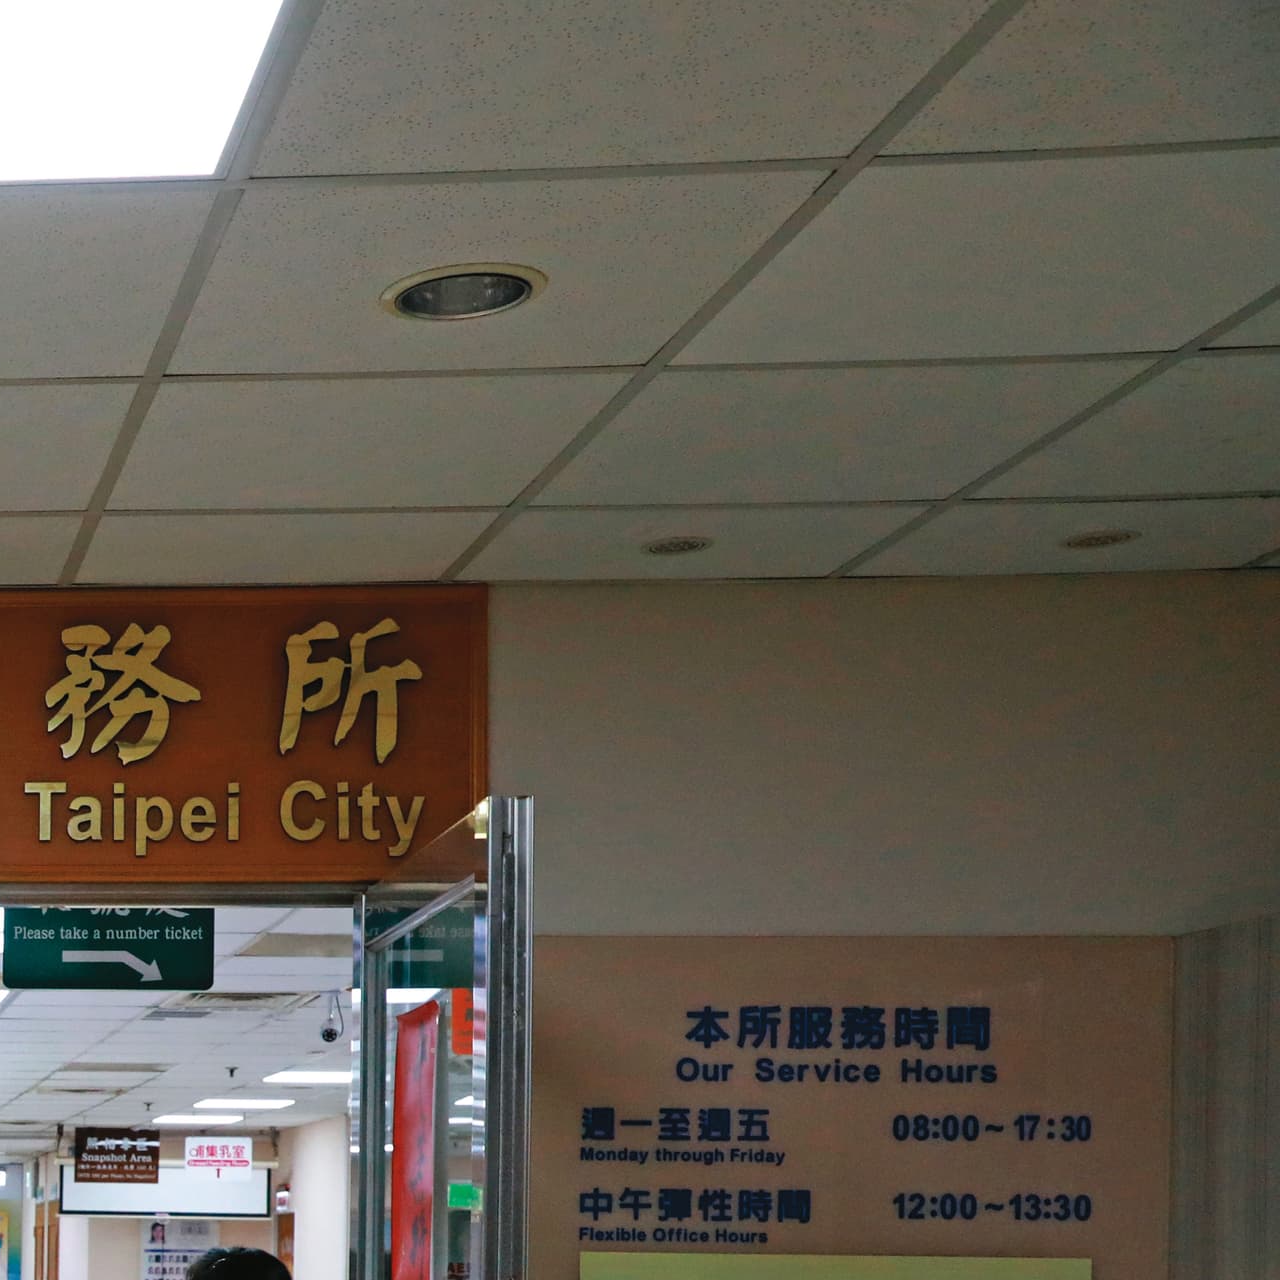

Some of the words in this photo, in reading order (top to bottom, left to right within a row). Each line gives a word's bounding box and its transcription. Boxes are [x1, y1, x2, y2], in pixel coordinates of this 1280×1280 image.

[24, 780, 240, 856] Taipei
[279, 780, 425, 857] City
[13, 926, 55, 940] Please
[60, 926, 88, 940] take
[93, 930, 101, 939] a
[106, 927, 160, 940] number
[165, 926, 204, 940] ticket
[685, 1005, 992, 1052] 本所服務時間
[676, 1058, 733, 1083] Our
[755, 1058, 880, 1083] Service
[900, 1058, 998, 1084] Hours
[581, 1107, 771, 1142] 週一至週五
[82, 1153, 126, 1164] Snapshot
[130, 1153, 152, 1162] Area
[580, 1147, 648, 1165] Monday
[655, 1147, 725, 1165] through
[729, 1148, 785, 1166] Friday
[579, 1188, 811, 1224] 中午彈性時間
[579, 1227, 647, 1243] Flexible
[652, 1228, 710, 1244] Office
[715, 1229, 768, 1245] Hours
